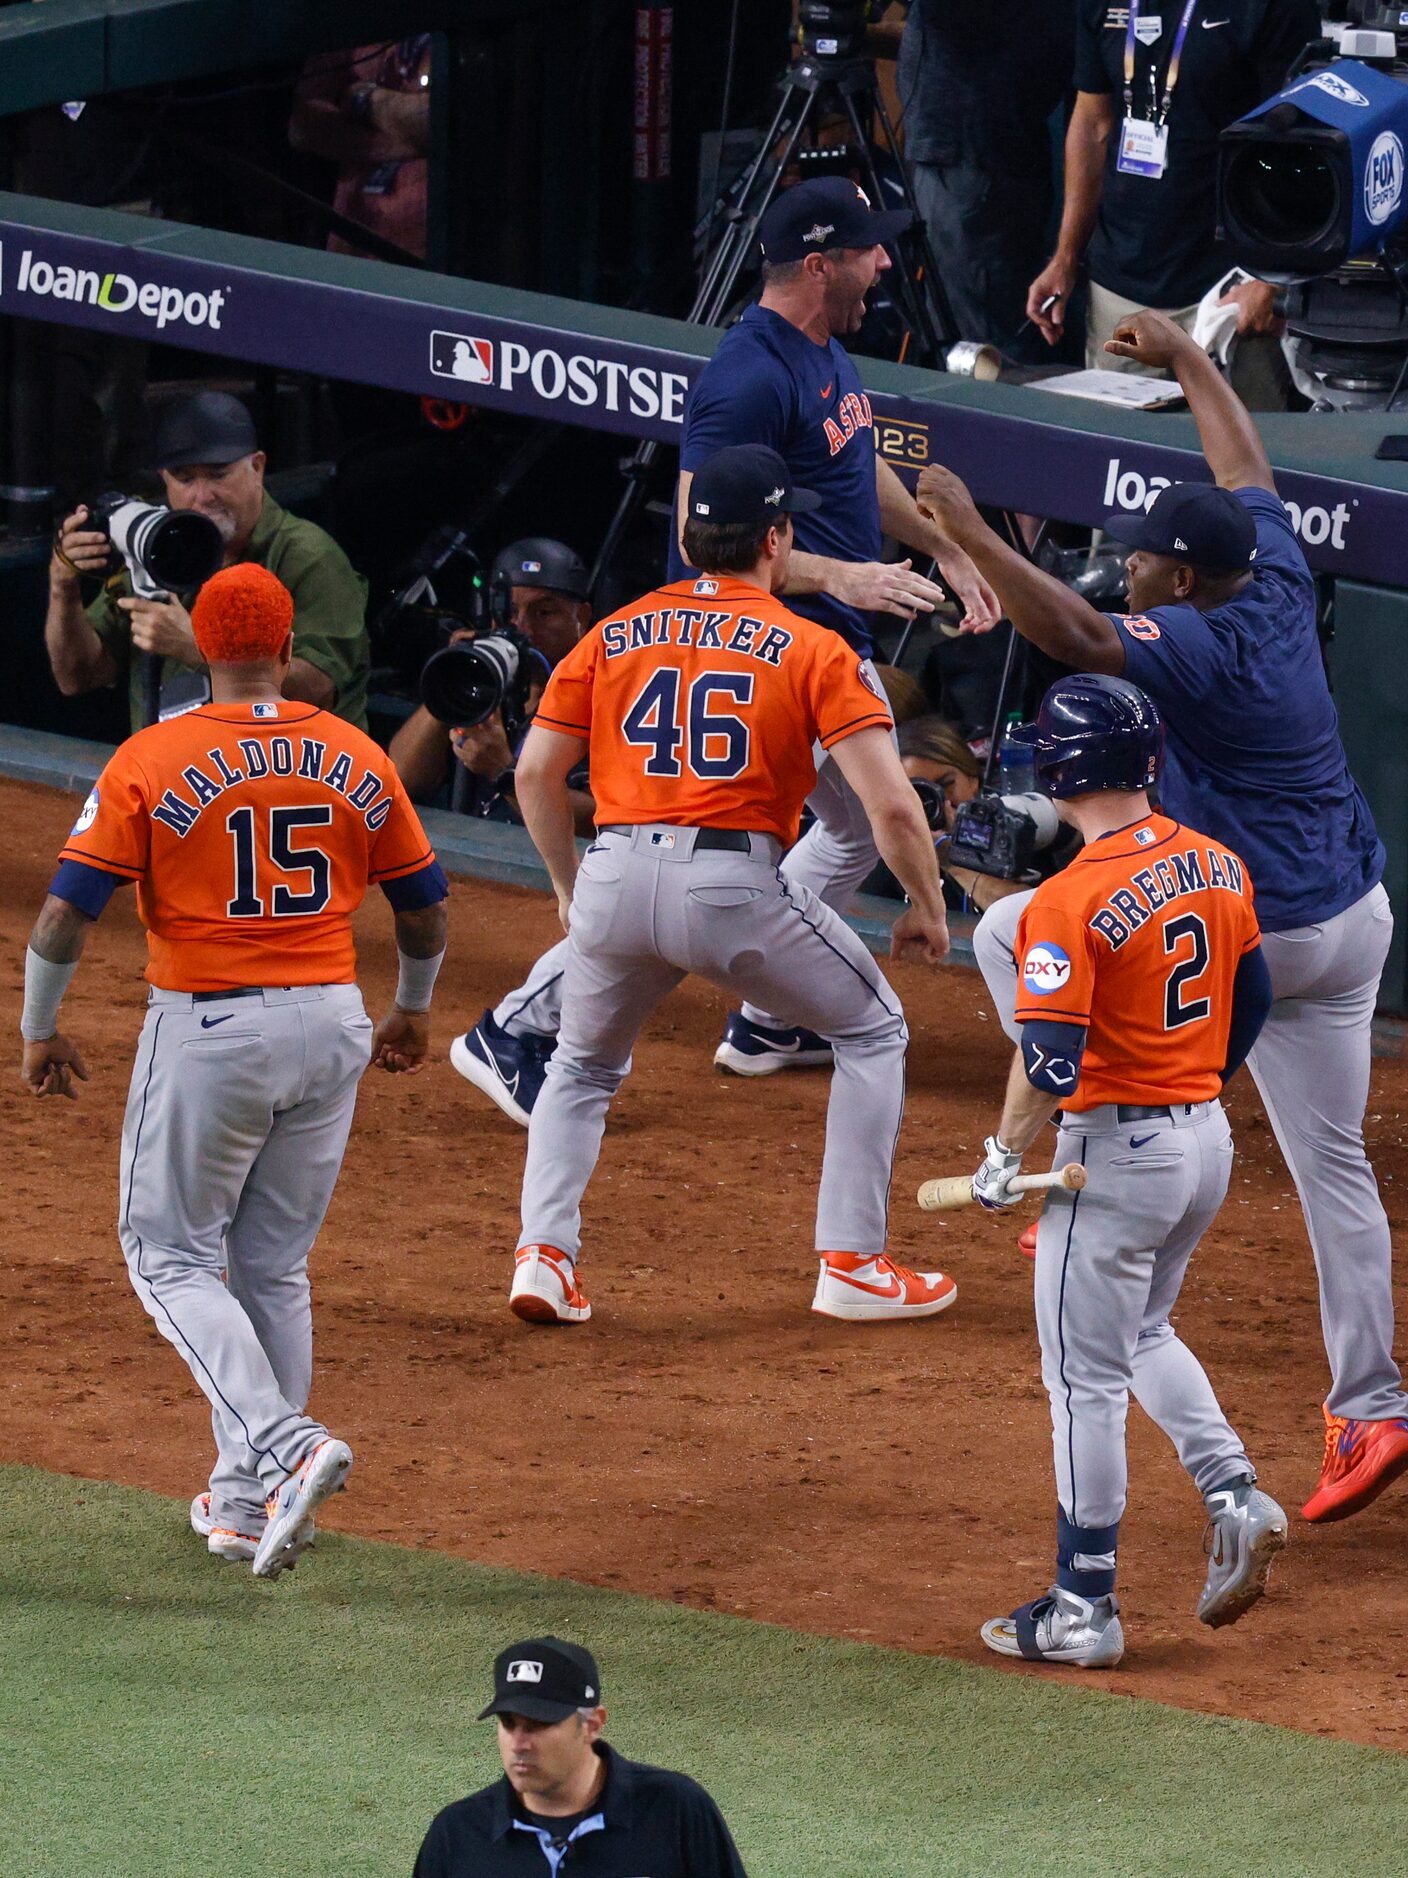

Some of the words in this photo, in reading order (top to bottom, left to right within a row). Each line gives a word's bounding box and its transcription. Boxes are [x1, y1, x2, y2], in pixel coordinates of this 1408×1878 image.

[1372, 186, 1395, 210] SPORTS
[1373, 147, 1395, 193] FOX
[17, 250, 225, 329] loanDepot
[500, 341, 689, 423] POSTSE
[874, 426, 929, 459] 23
[823, 392, 873, 457] ASTRO
[602, 608, 794, 667] SNITKER
[621, 666, 755, 779] 46
[151, 737, 393, 839] MALDONADO
[1147, 756, 1156, 772] 2
[226, 804, 333, 918] 15
[1088, 849, 1243, 952] BREGMAN
[1025, 962, 1069, 977] OXY
[1162, 912, 1211, 1031] 2
